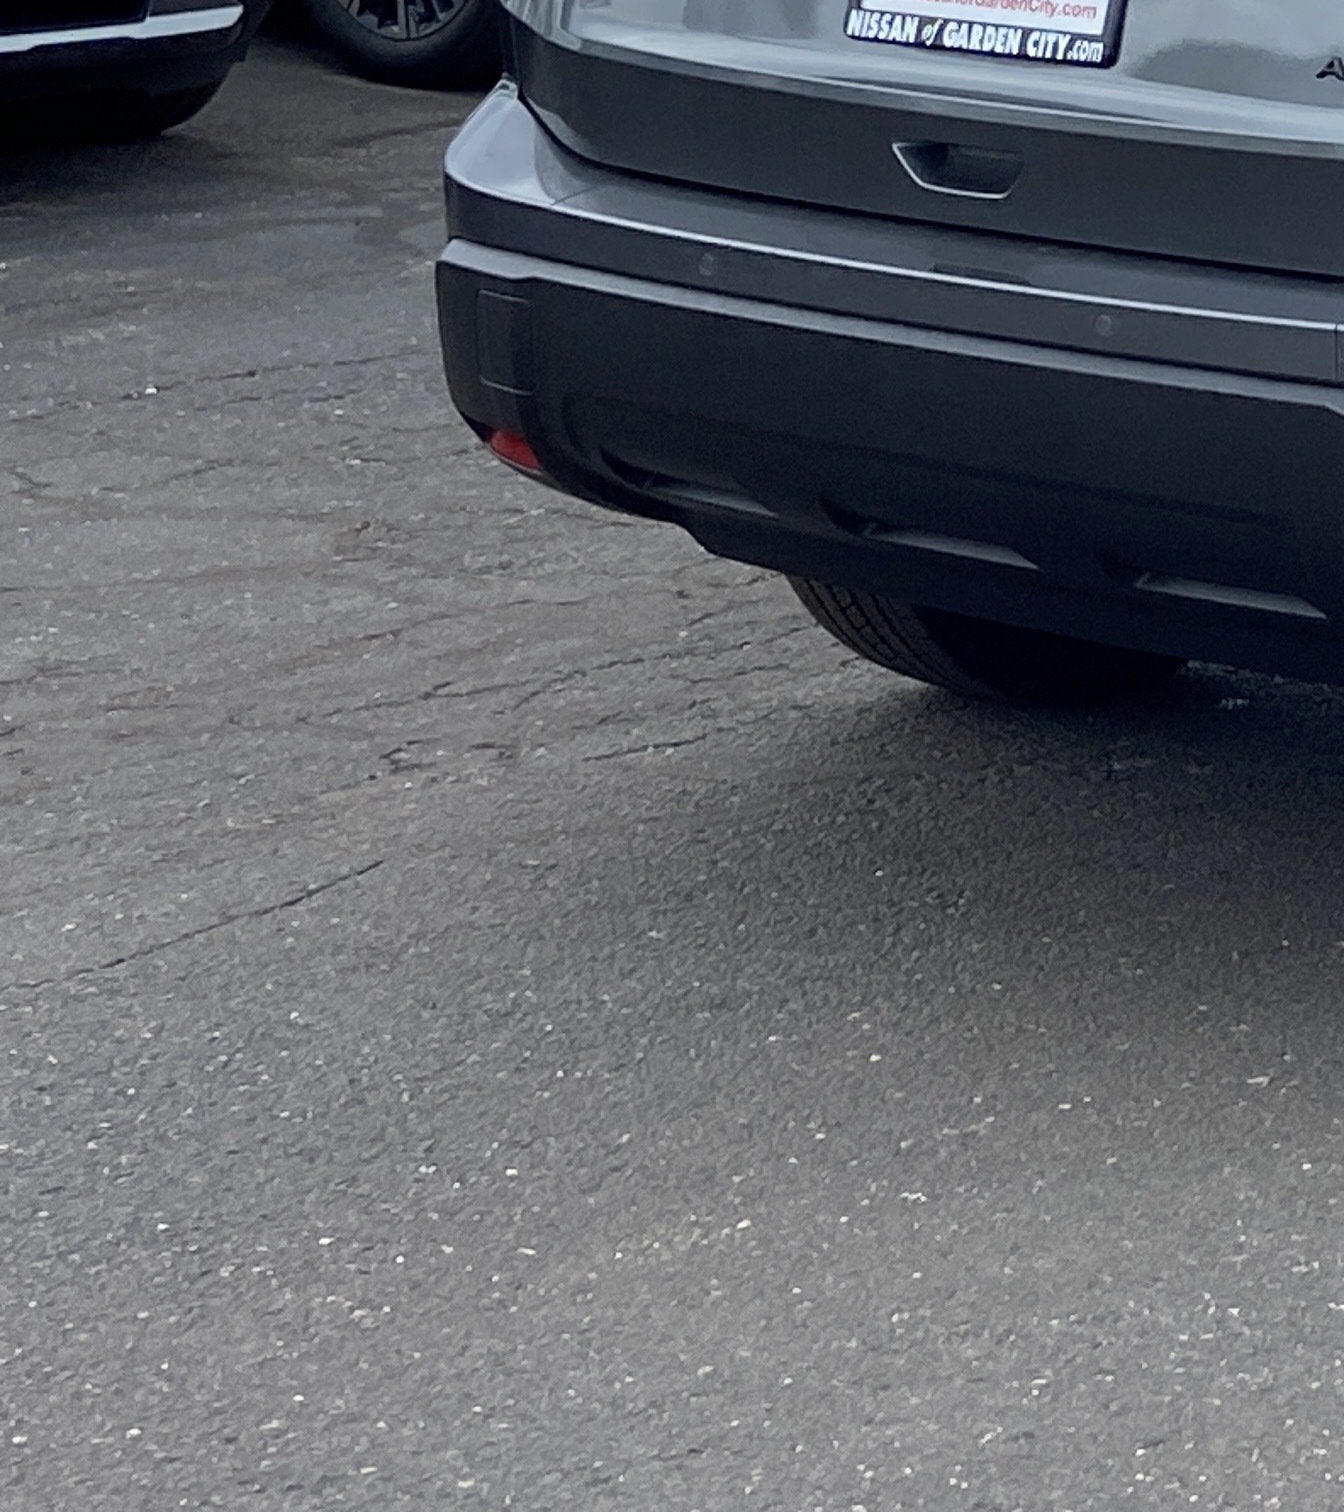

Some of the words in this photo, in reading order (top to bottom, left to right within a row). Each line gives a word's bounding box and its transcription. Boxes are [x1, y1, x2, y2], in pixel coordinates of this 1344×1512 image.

[846, 9, 919, 43] NISSAN
[921, 19, 944, 47] of
[943, 22, 1023, 57] GARDEN
